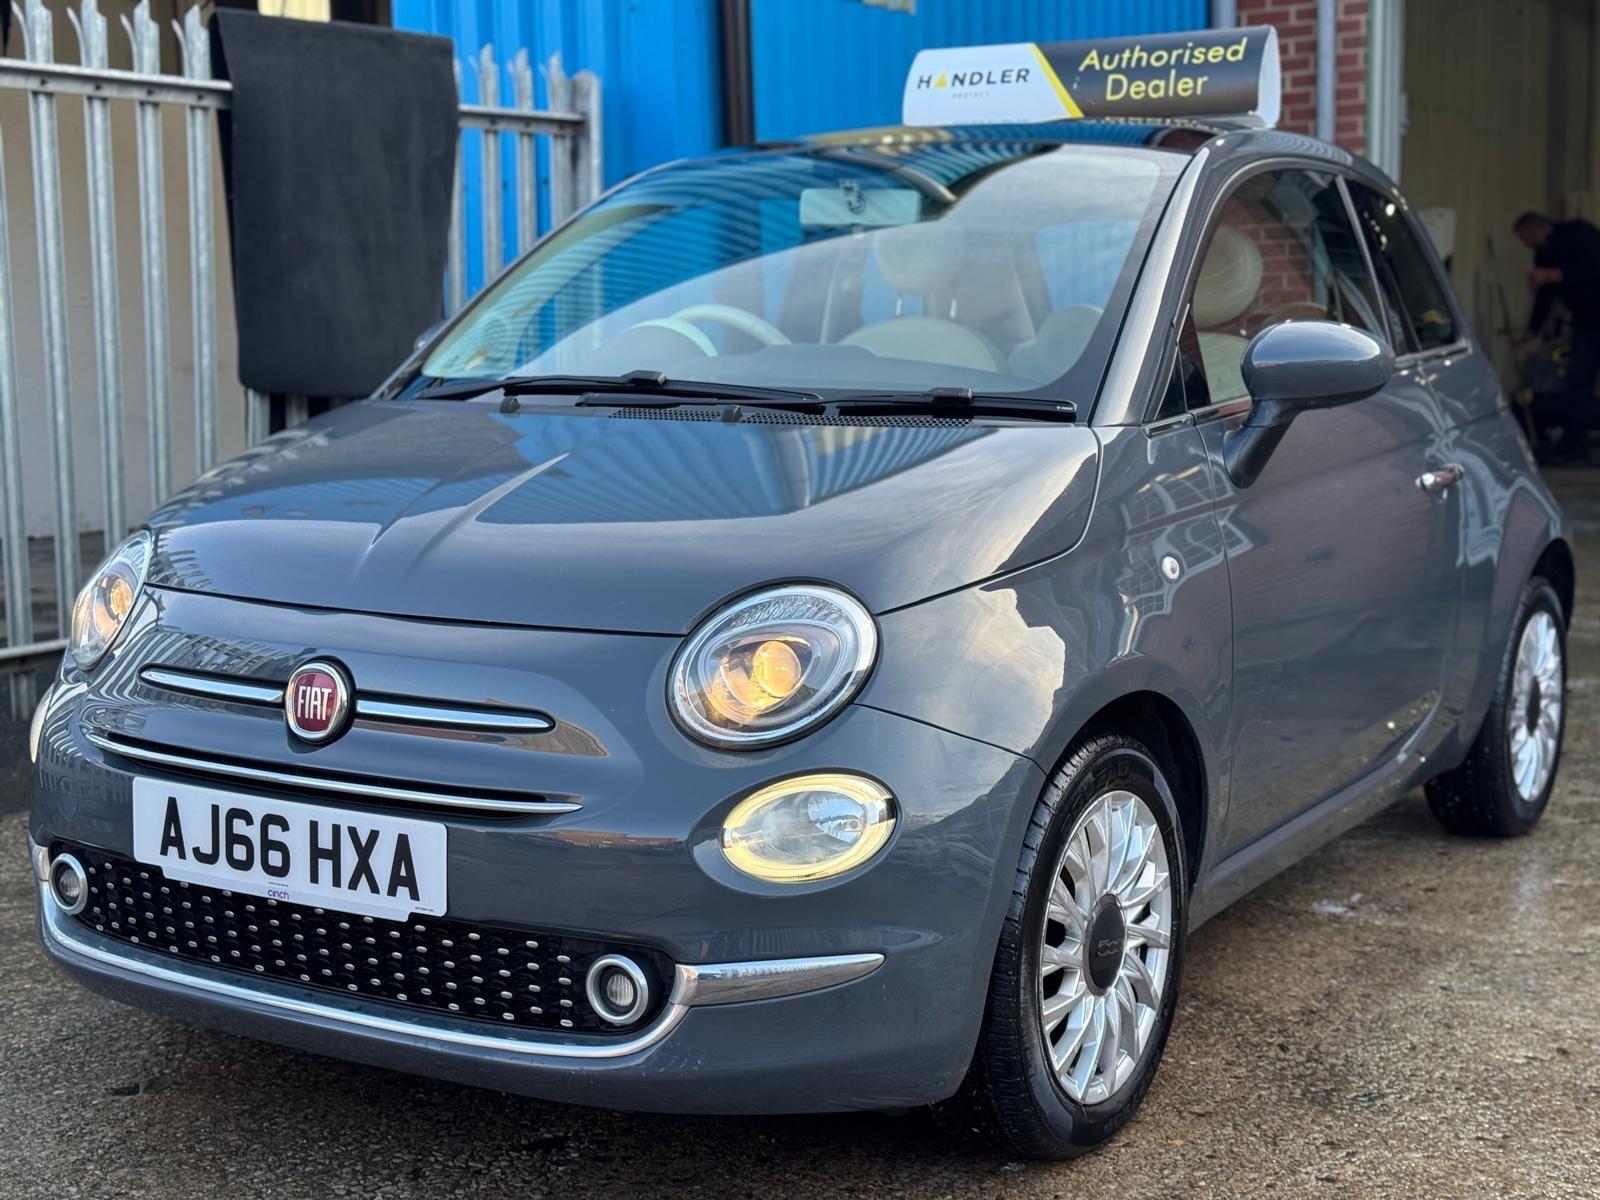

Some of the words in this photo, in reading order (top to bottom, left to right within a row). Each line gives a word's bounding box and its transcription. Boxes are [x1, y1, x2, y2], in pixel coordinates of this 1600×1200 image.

[1078, 37, 1248, 72] Authorised
[917, 68, 1030, 89] HANDLER
[1105, 68, 1209, 101] Dealer
[297, 685, 333, 721] FIAT
[159, 796, 291, 878] AJ66
[309, 820, 421, 902] HXA
[267, 889, 290, 900] cinch
